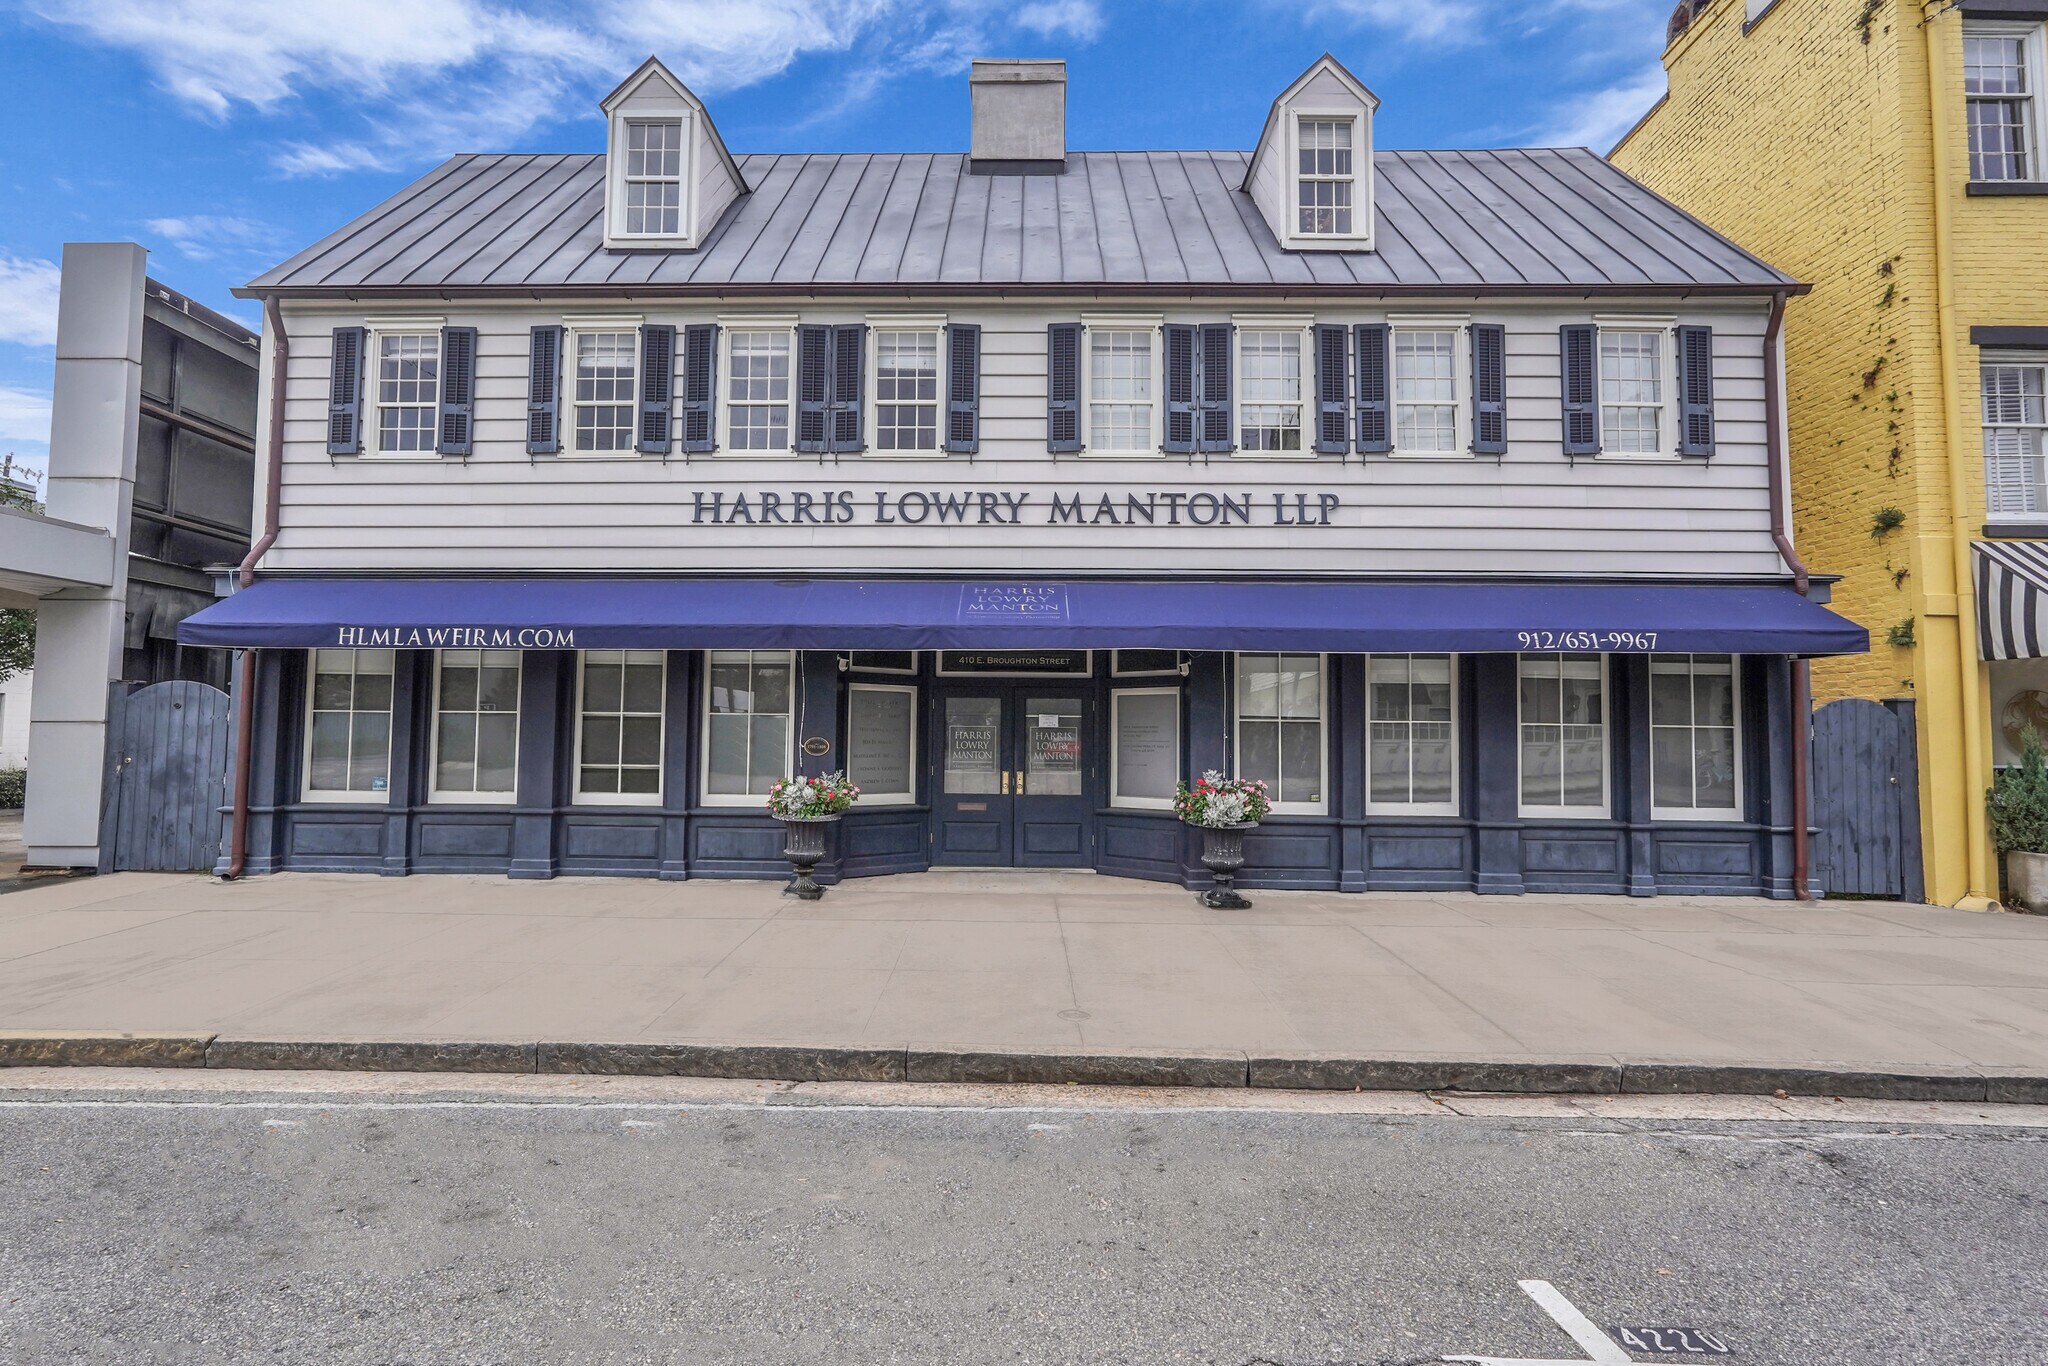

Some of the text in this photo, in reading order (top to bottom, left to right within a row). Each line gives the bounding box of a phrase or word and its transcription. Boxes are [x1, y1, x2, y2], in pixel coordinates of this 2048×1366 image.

[691, 490, 1341, 525] HARRIS LOWRY MANTON LLP
[974, 587, 1056, 595] HARRIS
[978, 595, 1050, 603] LOWRY
[967, 603, 1059, 611] MANTON
[337, 626, 576, 648] HLMLAWFIRM.COM
[1517, 631, 1658, 650] 912/651-9967
[959, 656, 975, 664] 410
[976, 656, 985, 664] E.
[955, 731, 991, 740] HARRIS
[1035, 731, 1072, 741] HARRIS
[956, 740, 989, 750] LOWRY
[1037, 741, 1069, 750] LOWRY
[952, 750, 992, 760] MANTON
[1033, 750, 1073, 760] MANTON
